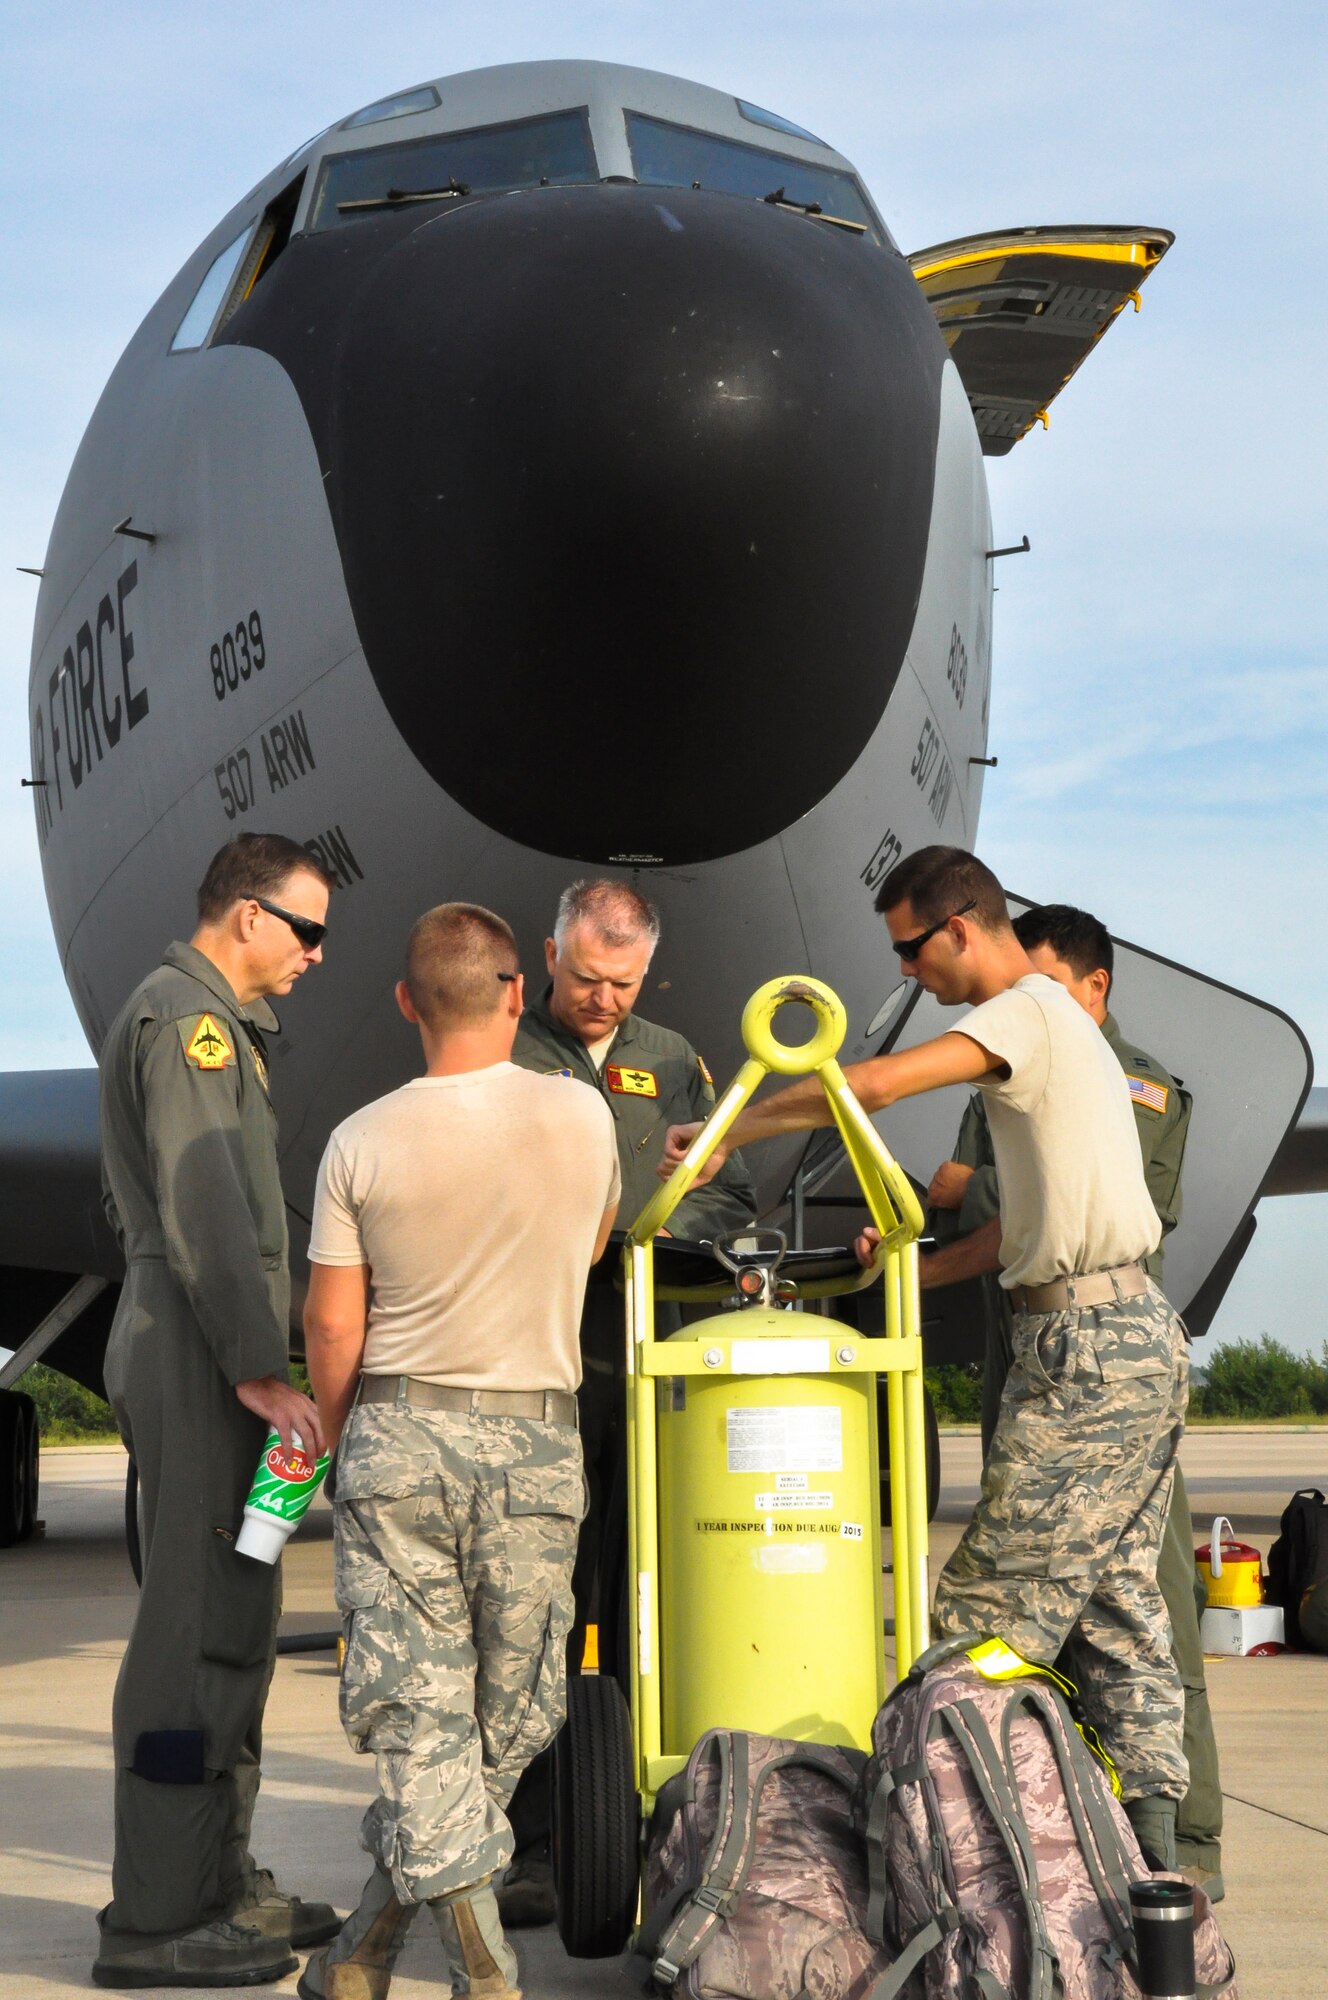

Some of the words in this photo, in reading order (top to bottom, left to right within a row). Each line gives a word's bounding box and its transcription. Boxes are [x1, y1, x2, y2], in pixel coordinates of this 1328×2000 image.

[49, 559, 150, 812] FORCE
[209, 610, 266, 701] 8039
[214, 747, 256, 820] 507
[260, 709, 316, 793] ARW
[910, 716, 941, 792] 507
[258, 1492, 284, 1512] 44
[703, 1522, 728, 1531] YEAR
[730, 1522, 793, 1532] INSPECION
[796, 1523, 816, 1533] DUE
[843, 1526, 862, 1537] 2015
